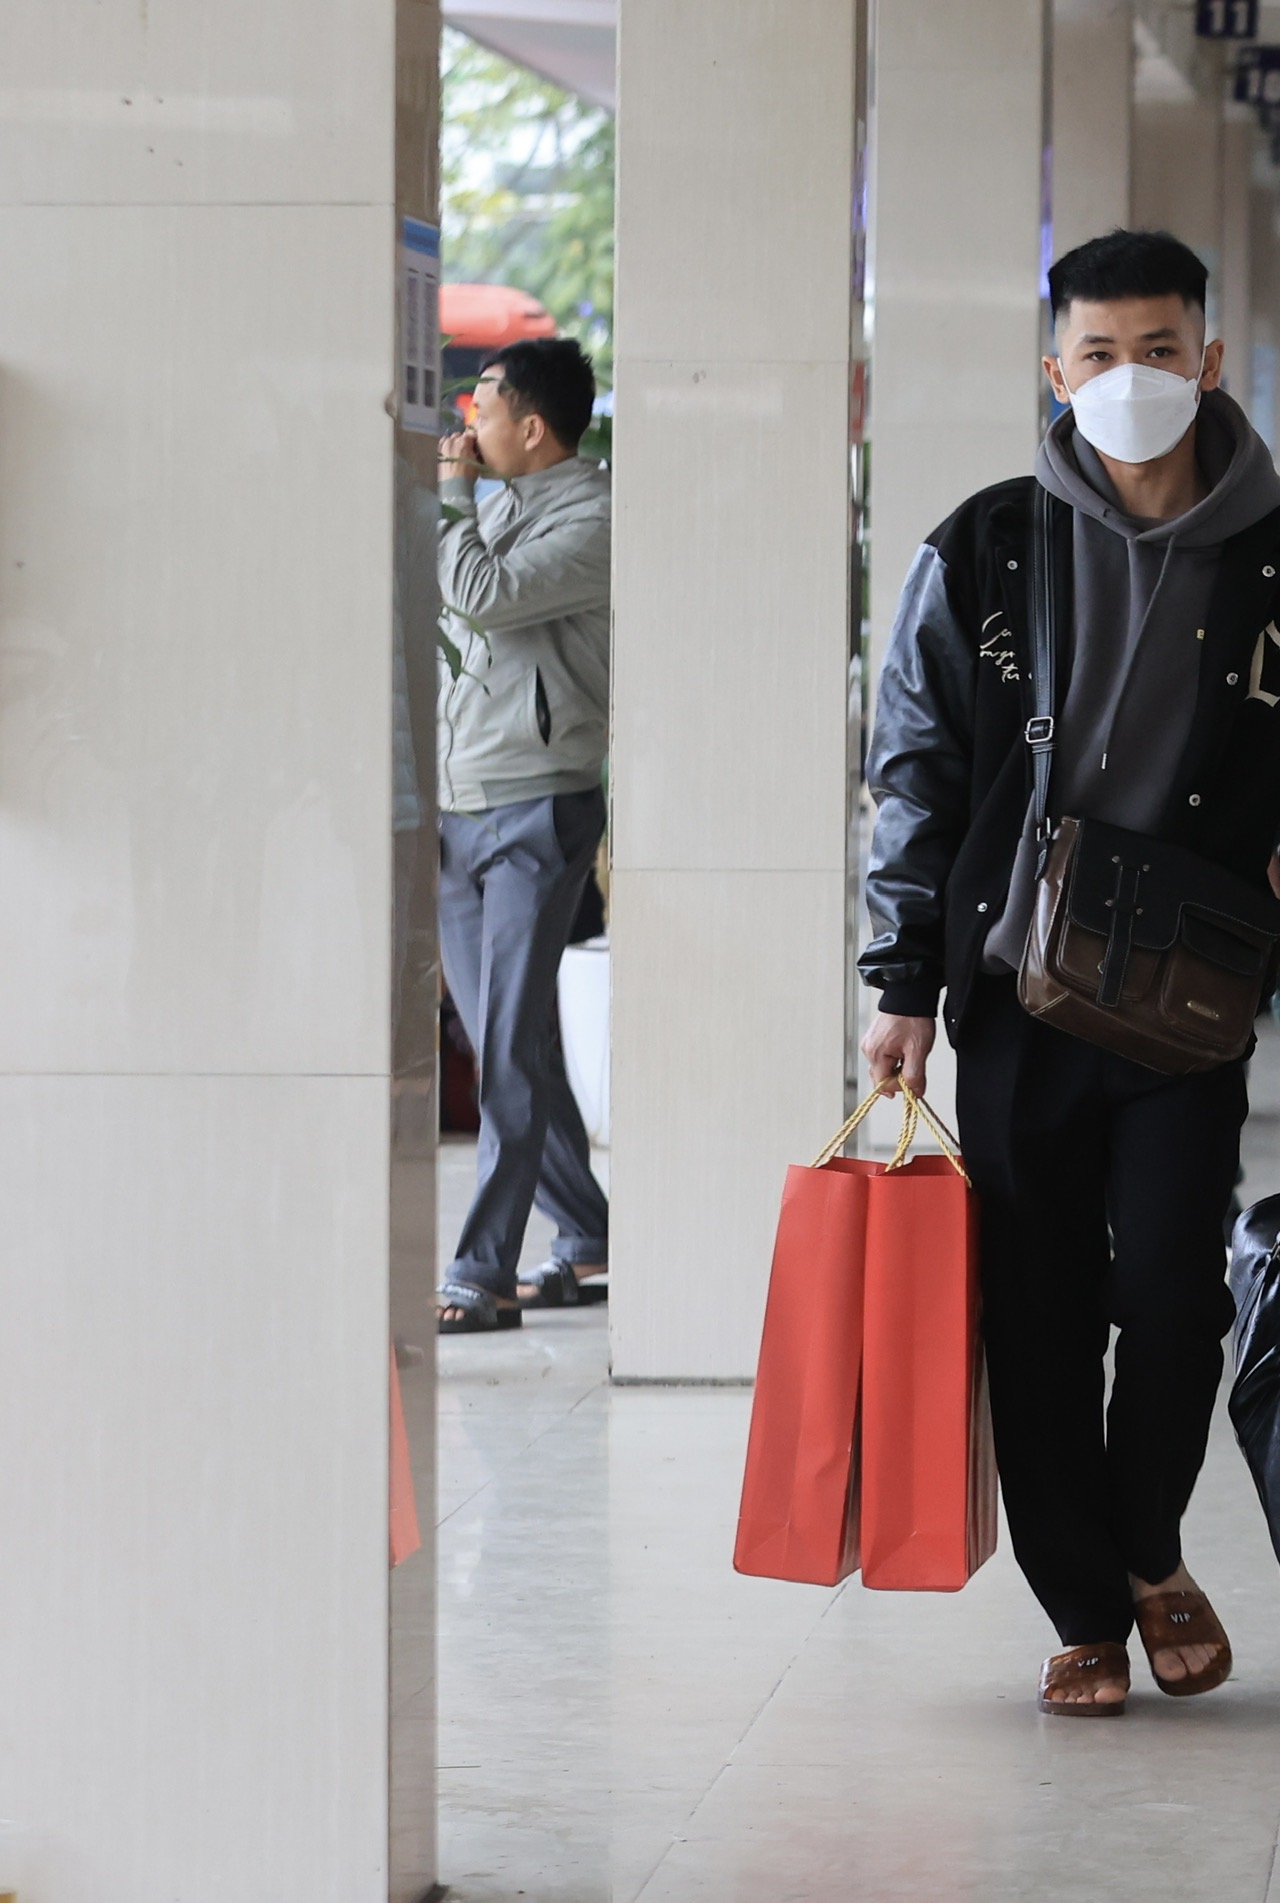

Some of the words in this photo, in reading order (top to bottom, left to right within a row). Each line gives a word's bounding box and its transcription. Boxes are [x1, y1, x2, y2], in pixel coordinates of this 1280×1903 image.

[1209, 0, 1248, 34] 11
[1170, 1612, 1191, 1624] VIP
[1077, 1656, 1099, 1668] VIP
